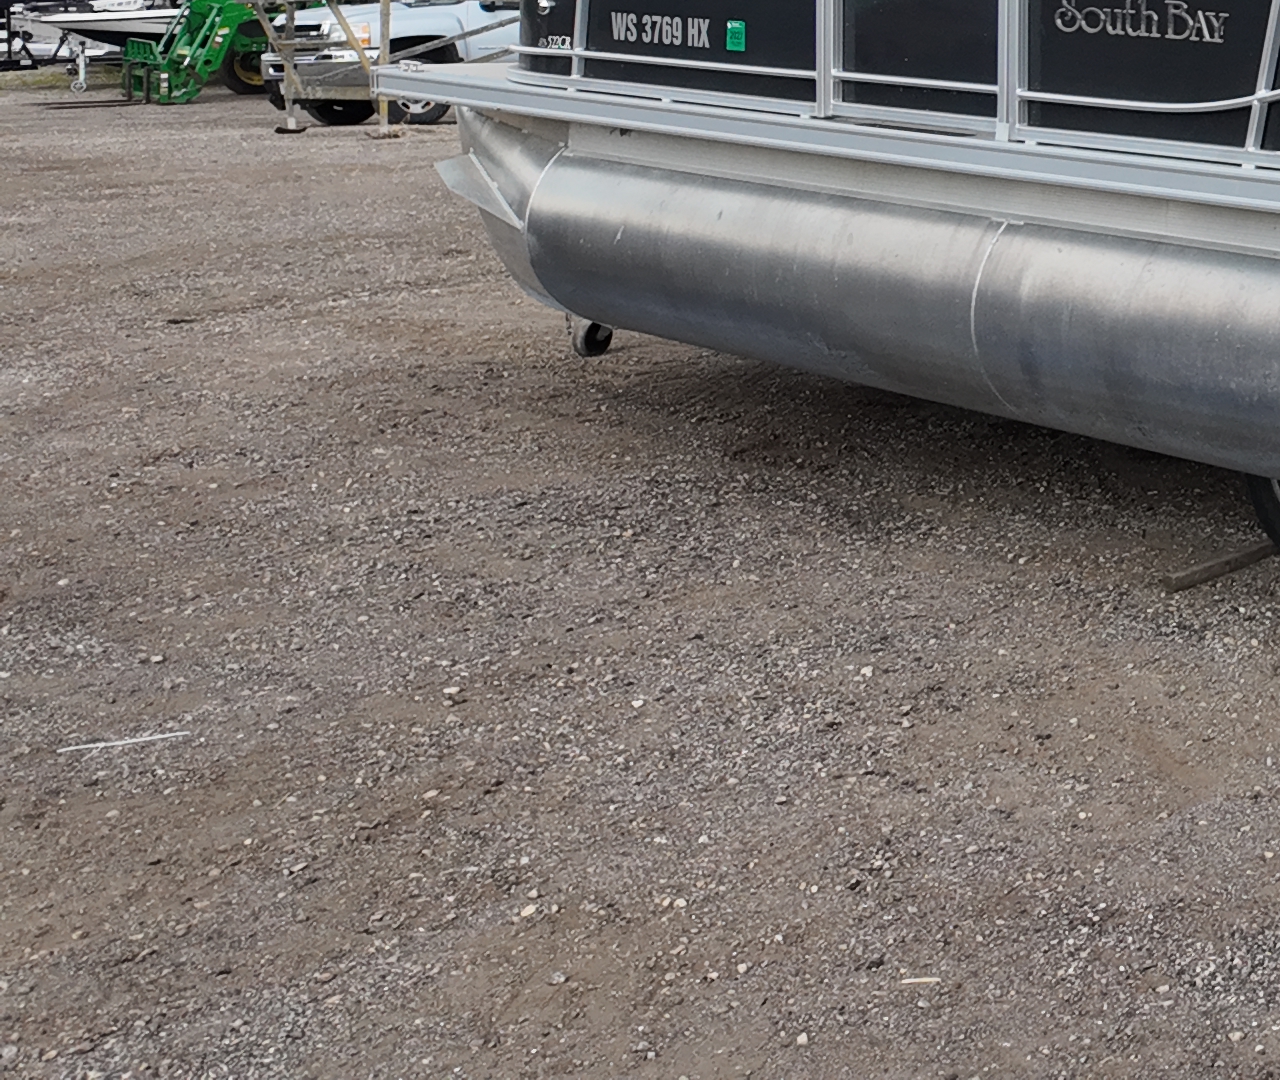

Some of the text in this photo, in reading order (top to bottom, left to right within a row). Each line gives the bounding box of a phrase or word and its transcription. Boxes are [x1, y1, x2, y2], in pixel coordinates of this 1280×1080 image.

[611, 11, 711, 49] WS 3769 HX
